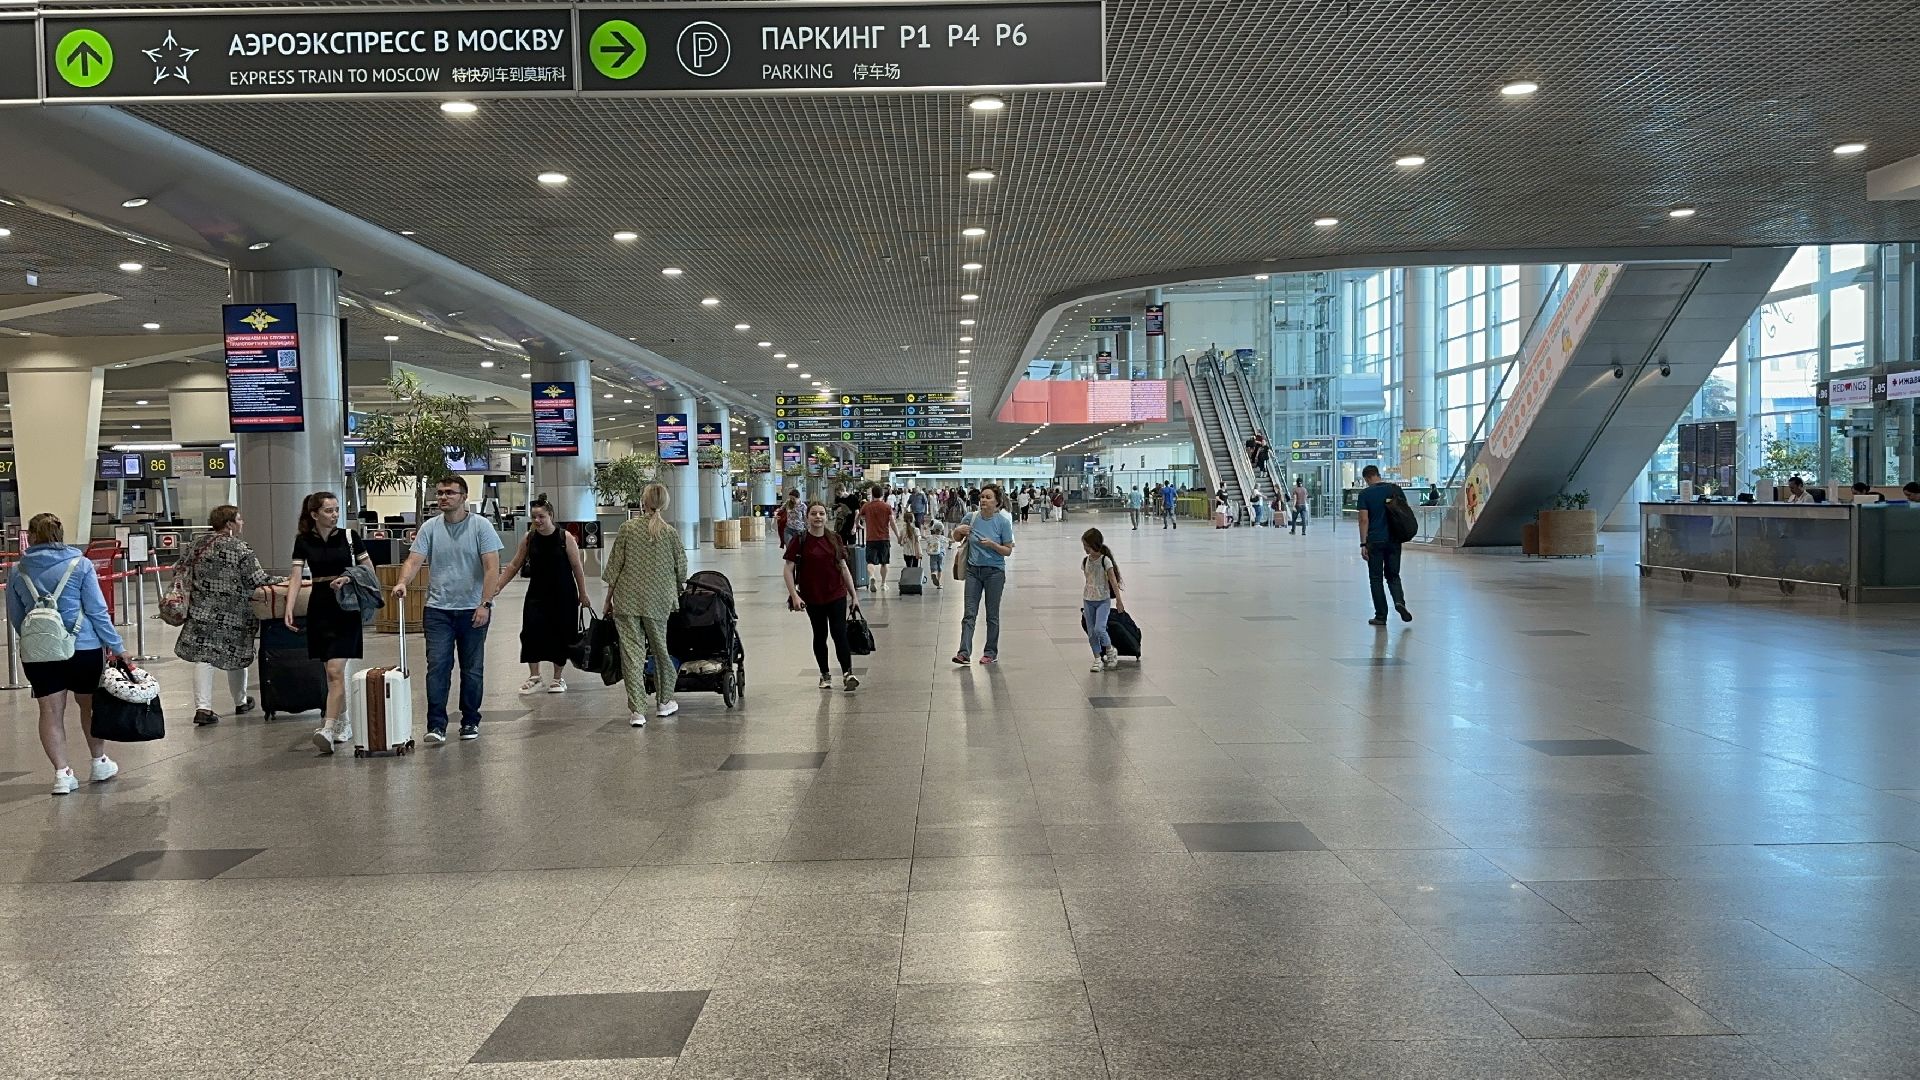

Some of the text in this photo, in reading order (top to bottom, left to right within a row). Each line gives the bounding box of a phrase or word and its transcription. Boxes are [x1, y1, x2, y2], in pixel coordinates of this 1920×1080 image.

[229, 29, 564, 56] АЭРОЭКСПРЕСС В МОСКВУ
[762, 23, 1028, 50] ПАРКИНГ P1 P4 P6
[230, 67, 440, 85] EXPRESS TRAIN TO MOSCOW
[451, 66, 567, 83] 特快列车到莫斯科
[762, 63, 833, 80] PARKING
[852, 63, 901, 80] 停车场
[150, 459, 166, 471] 86
[209, 458, 225, 470] 85
